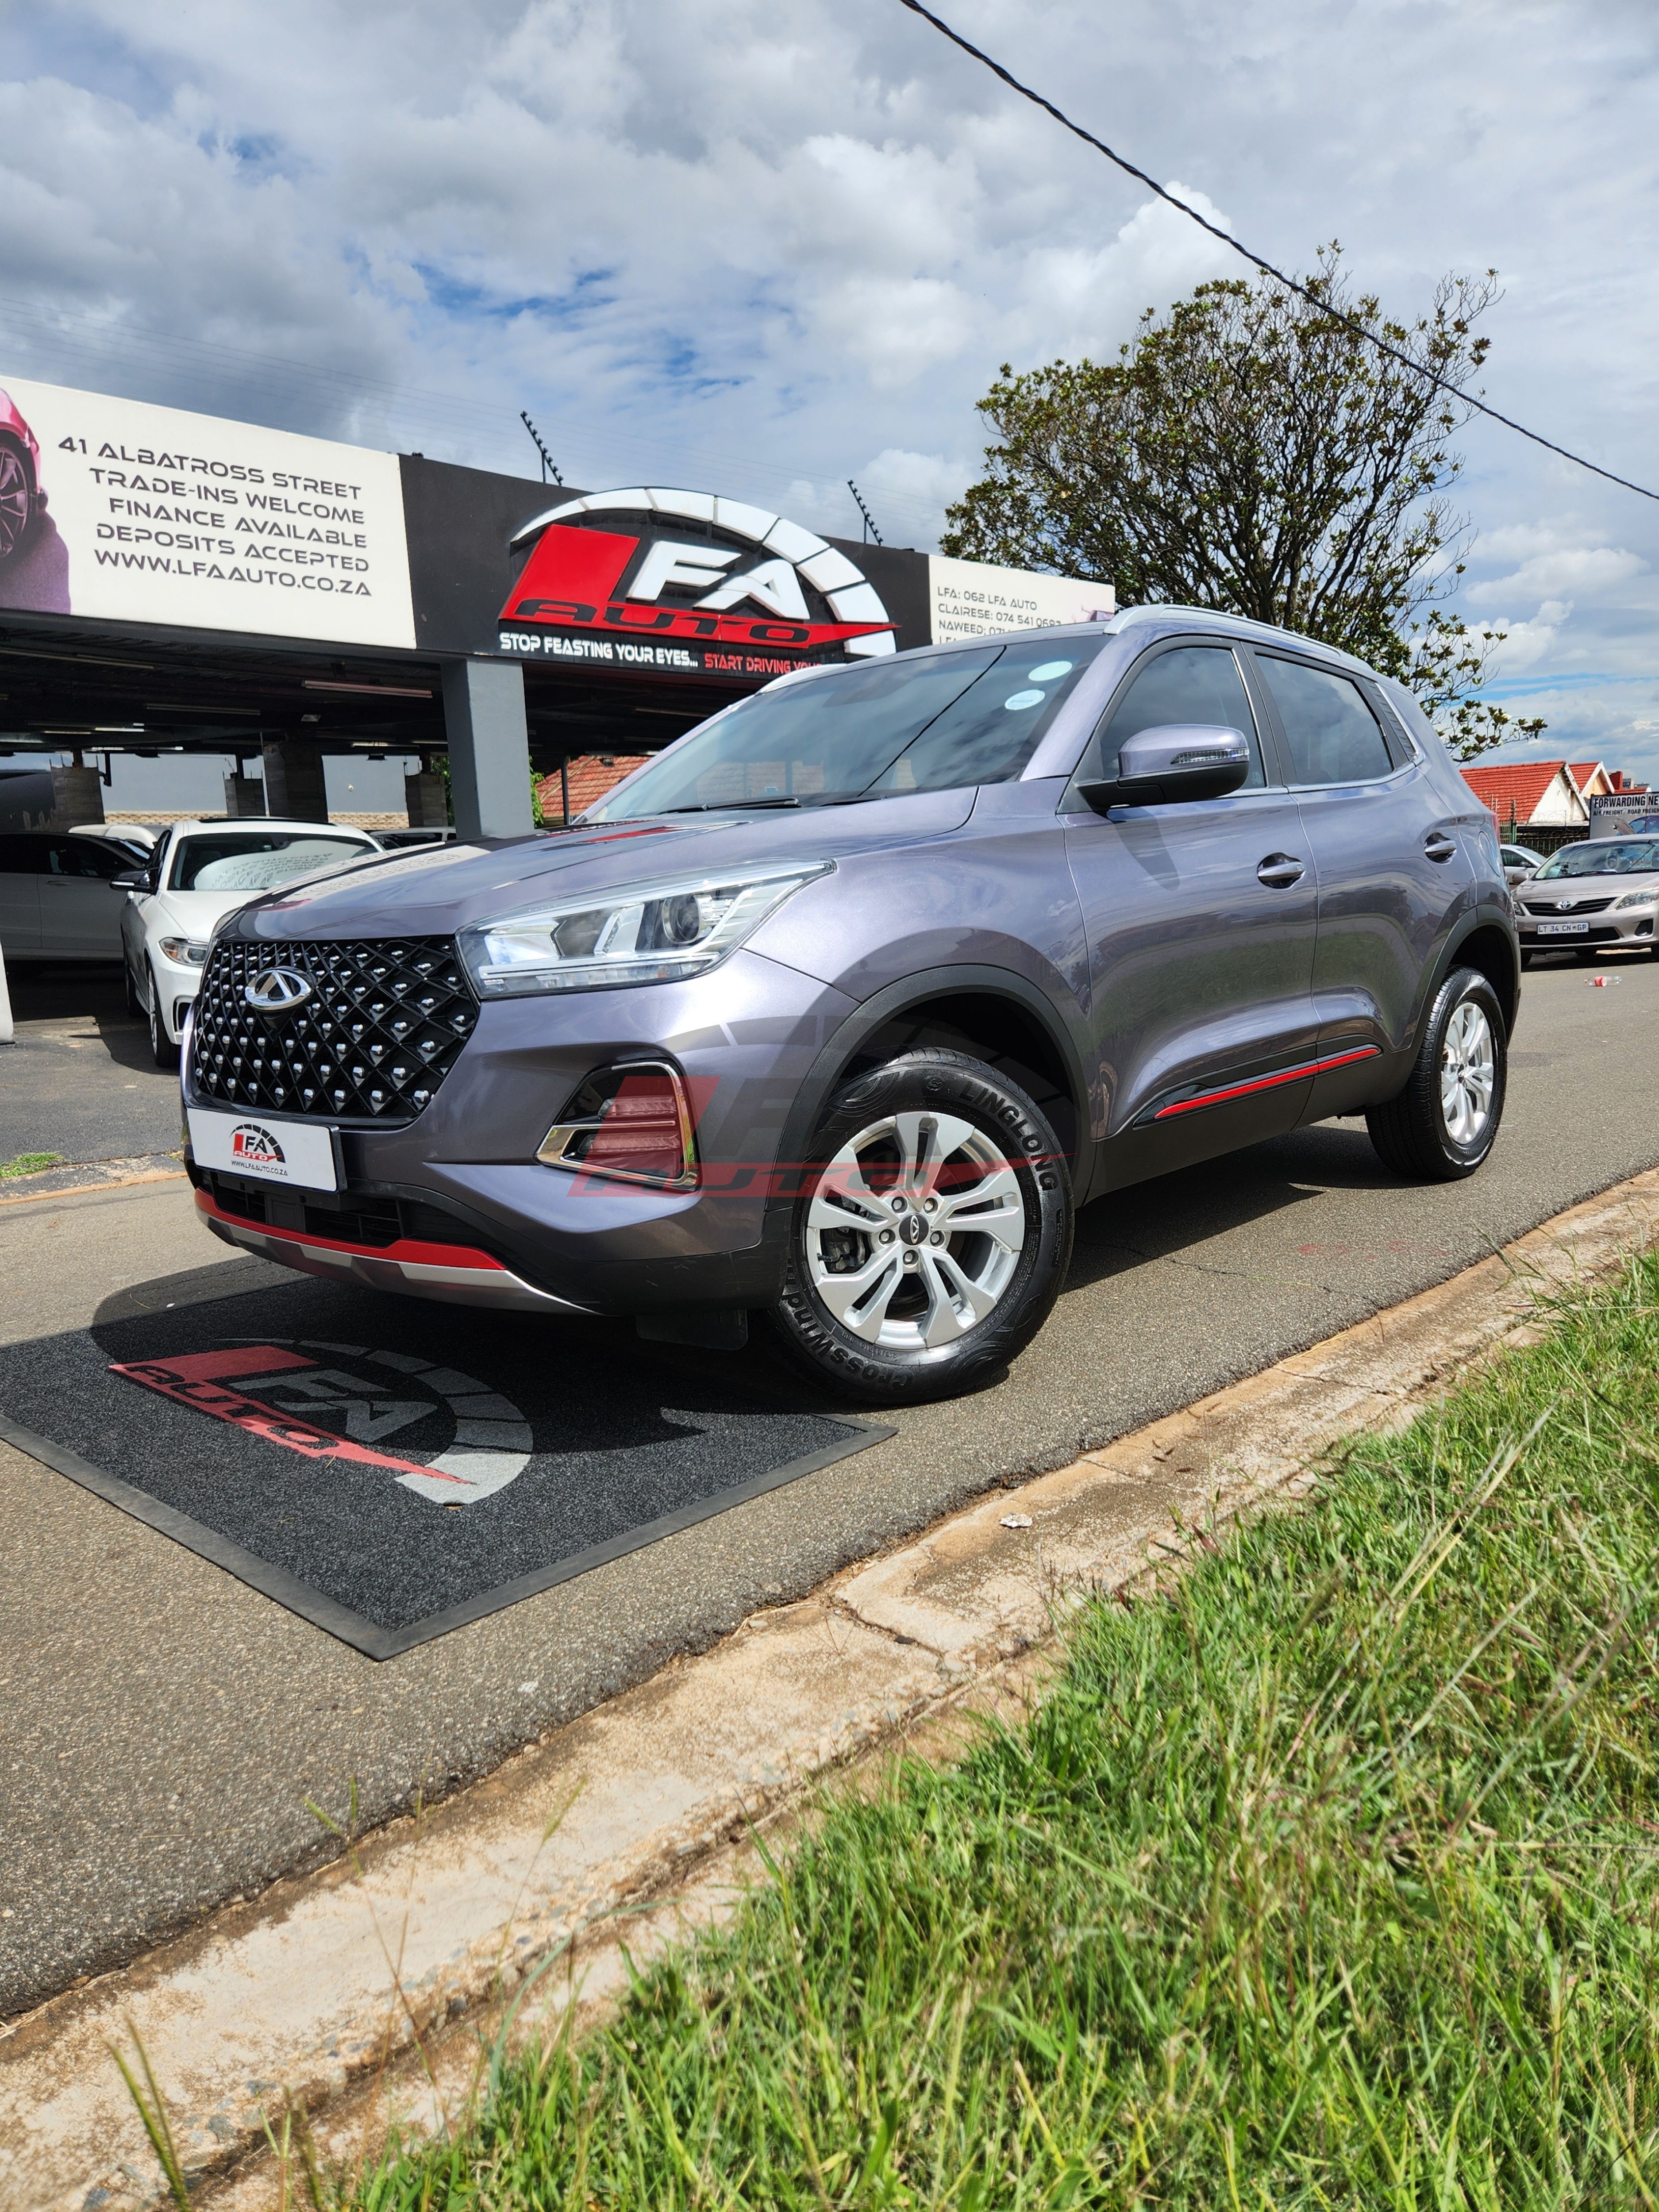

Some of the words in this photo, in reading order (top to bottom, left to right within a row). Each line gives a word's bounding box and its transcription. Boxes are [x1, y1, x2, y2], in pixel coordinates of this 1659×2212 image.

[58, 437, 87, 454] 41
[98, 443, 265, 484] ALBATROSS
[272, 473, 362, 500] STREET
[89, 468, 238, 504] TRADE-INS
[245, 492, 365, 524] WELCOME
[110, 497, 225, 528] FINANCE
[235, 517, 367, 548] AVAILABLE
[97, 523, 235, 554] DEPOSITS
[244, 544, 369, 572] ACCEPTED
[94, 549, 371, 596] WWW.LFAAUTO.CO.ZA
[513, 598, 811, 643] AUTO
[938, 586, 960, 599] LFA:
[964, 591, 985, 602] 062
[988, 595, 1006, 606] LFA
[1010, 599, 1037, 610] AUTO
[939, 603, 993, 619] CLAIRESE:
[996, 612, 1014, 623] 074
[1017, 615, 1033, 626] 541
[499, 632, 541, 652] STOP
[543, 636, 613, 659] FEASTING
[615, 644, 654, 663] YOUR
[656, 647, 698, 667] EYES...
[704, 653, 743, 670] START
[746, 657, 791, 674] DRIVING
[1594, 796, 1646, 808] FORWARDING
[234, 1150, 268, 1160] AUTO
[958, 1081, 1059, 1191] LINGLONG
[231, 1160, 288, 1176] WWW.LFAAUTO.CO.ZA
